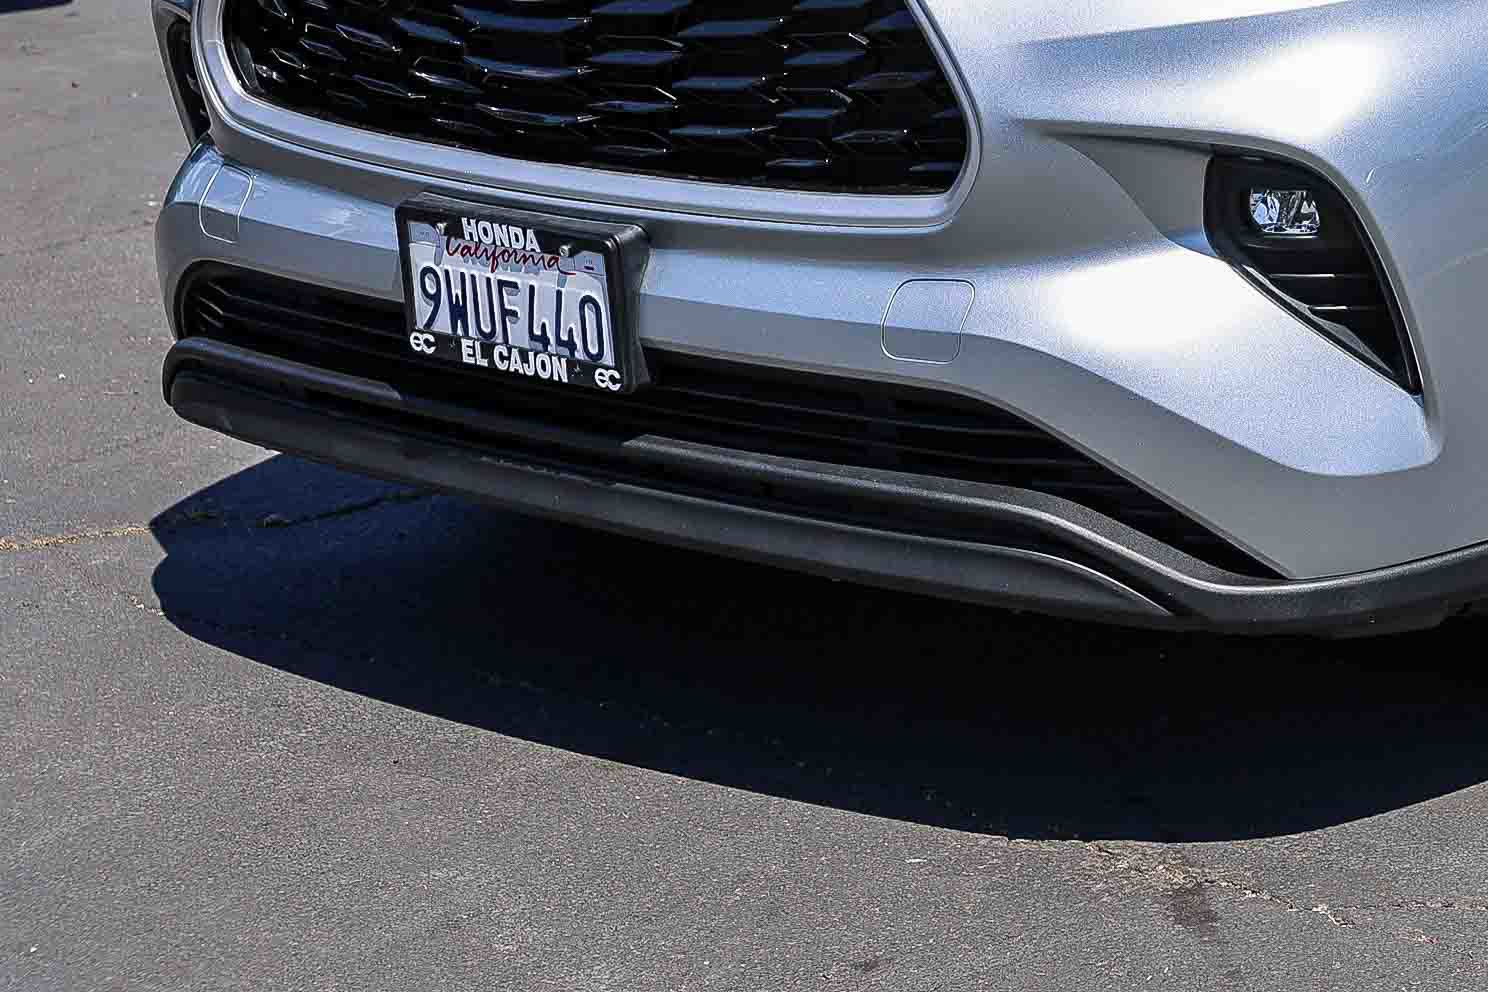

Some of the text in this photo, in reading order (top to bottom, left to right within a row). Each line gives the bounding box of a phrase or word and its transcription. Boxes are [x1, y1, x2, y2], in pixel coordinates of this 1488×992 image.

[445, 235, 576, 275] California
[460, 216, 541, 253] HONDA
[418, 264, 606, 362] 9WUF440
[461, 338, 569, 384] EL CAJON
